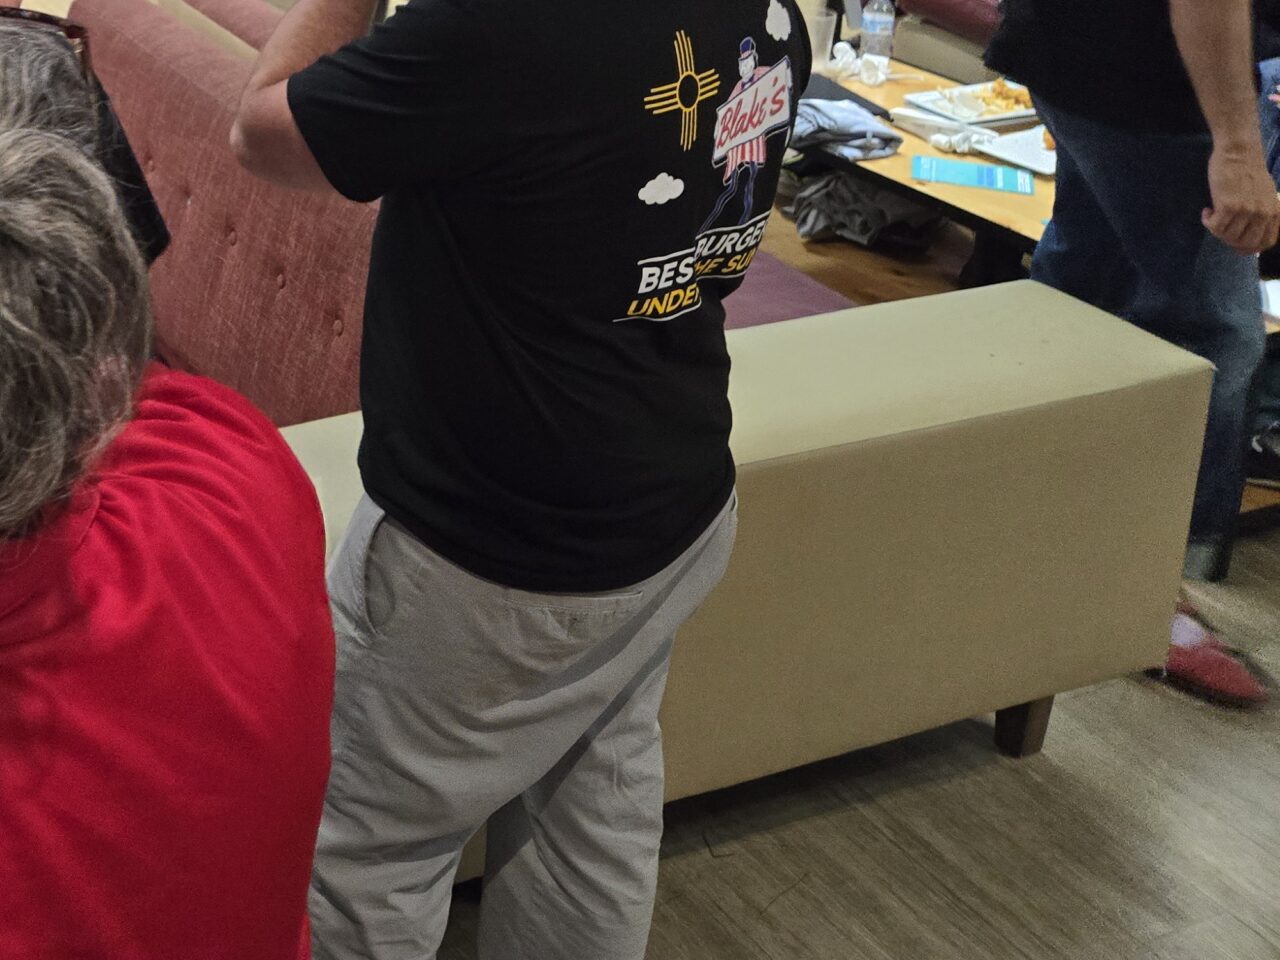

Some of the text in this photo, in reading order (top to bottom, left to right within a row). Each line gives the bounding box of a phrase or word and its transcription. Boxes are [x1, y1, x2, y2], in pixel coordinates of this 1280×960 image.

[717, 76, 786, 149] Blake's
[627, 283, 700, 316] UNDE
[694, 257, 724, 275] HE
[638, 220, 768, 294] BES BURGE
